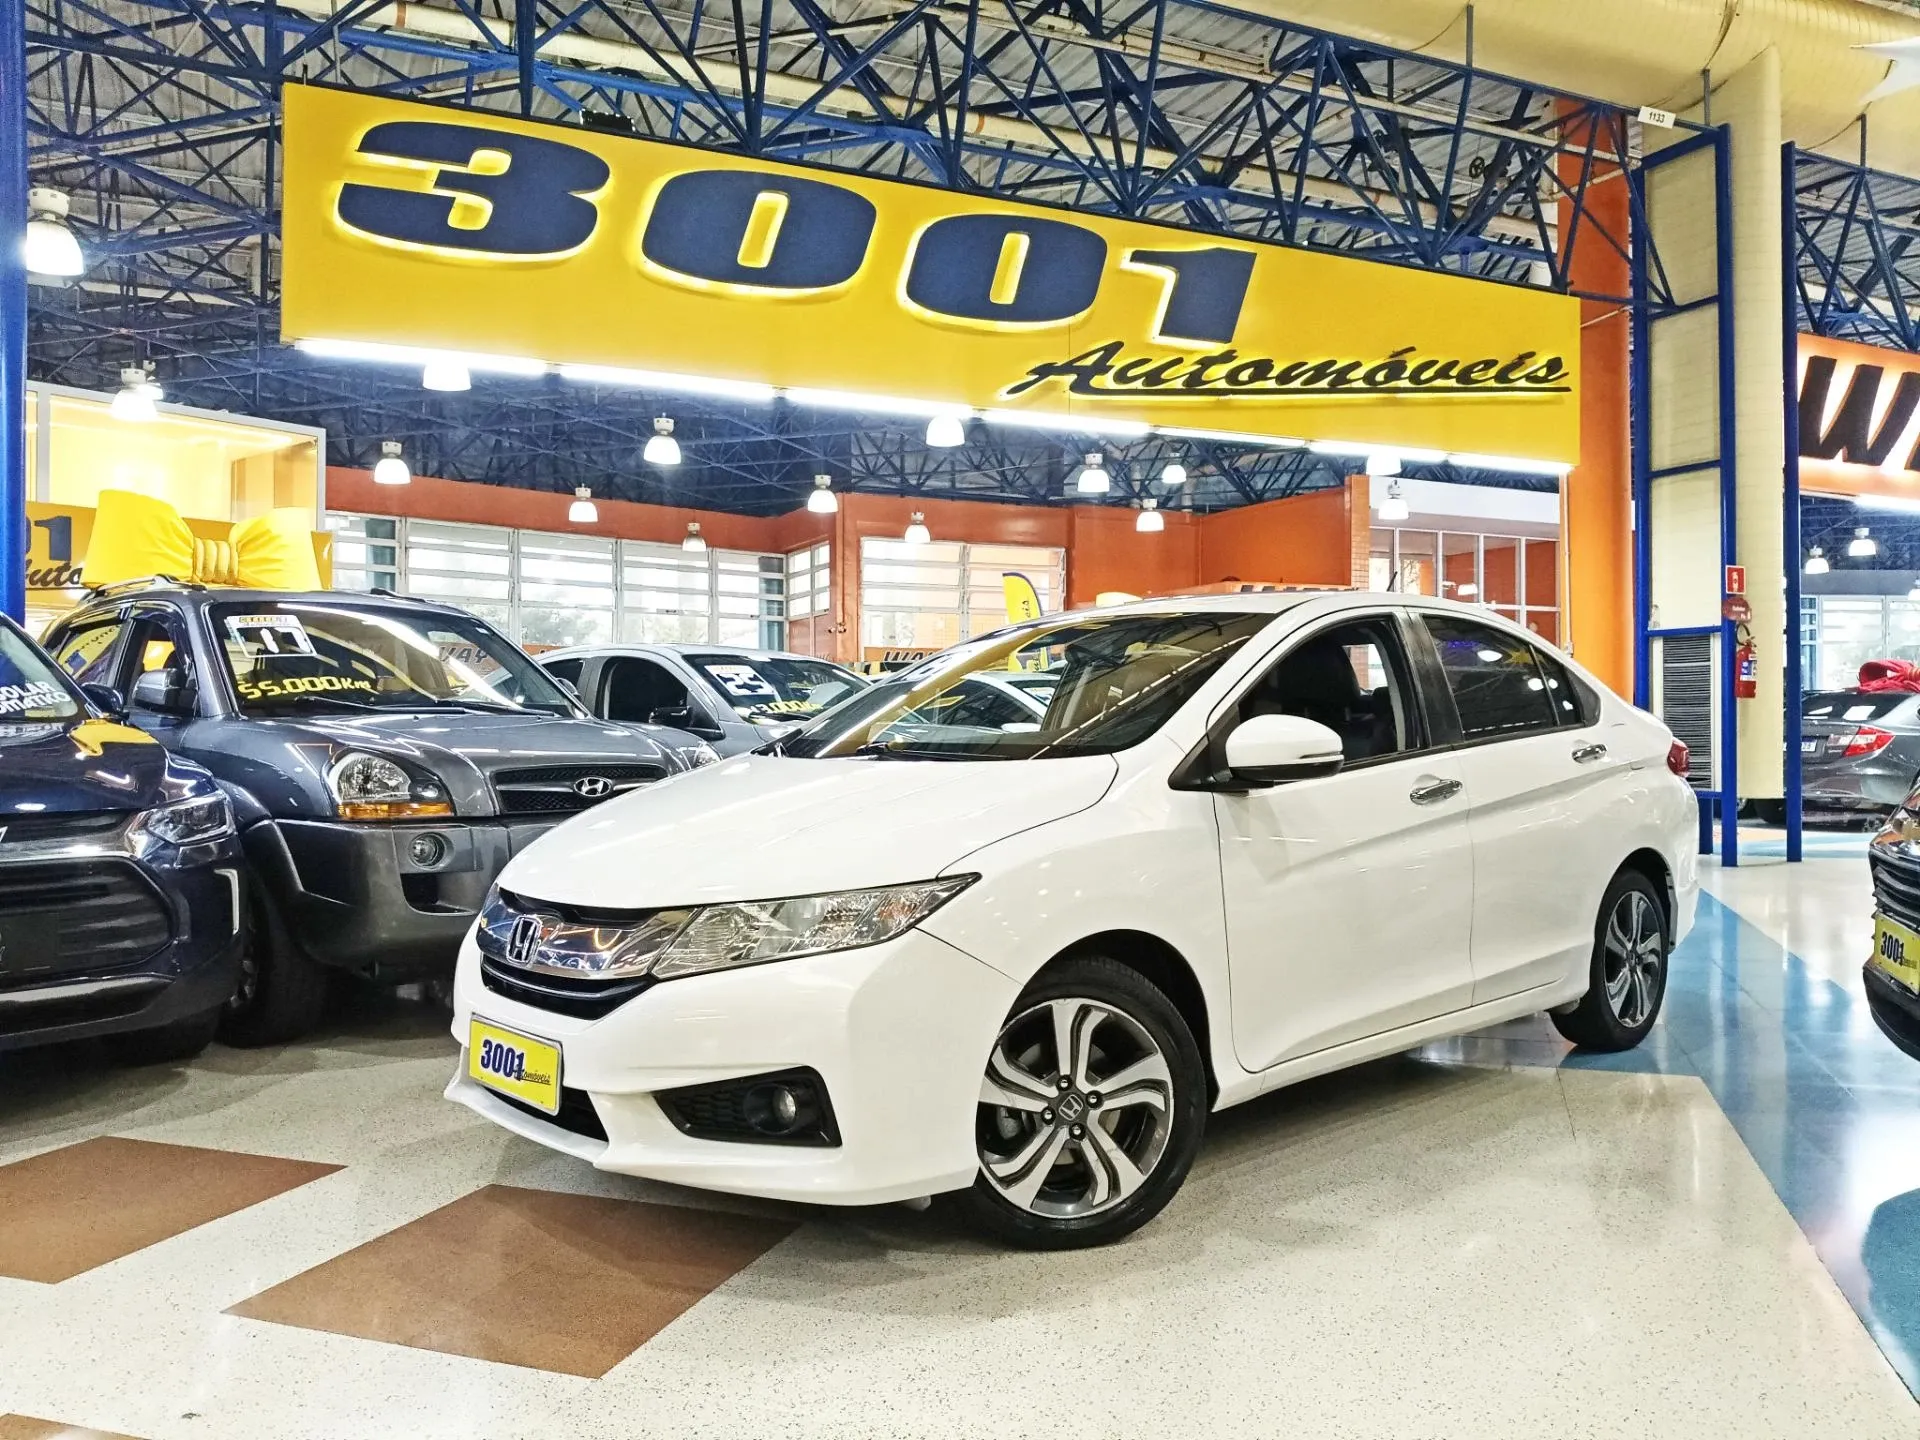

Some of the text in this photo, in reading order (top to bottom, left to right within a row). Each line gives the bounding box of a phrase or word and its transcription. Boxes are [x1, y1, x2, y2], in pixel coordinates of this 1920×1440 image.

[1649, 112, 1666, 123] 1133
[338, 120, 1258, 345] 3001
[1005, 340, 1572, 395] Automóveis
[1880, 931, 1905, 967] 3001
[481, 1039, 525, 1081] 3001
